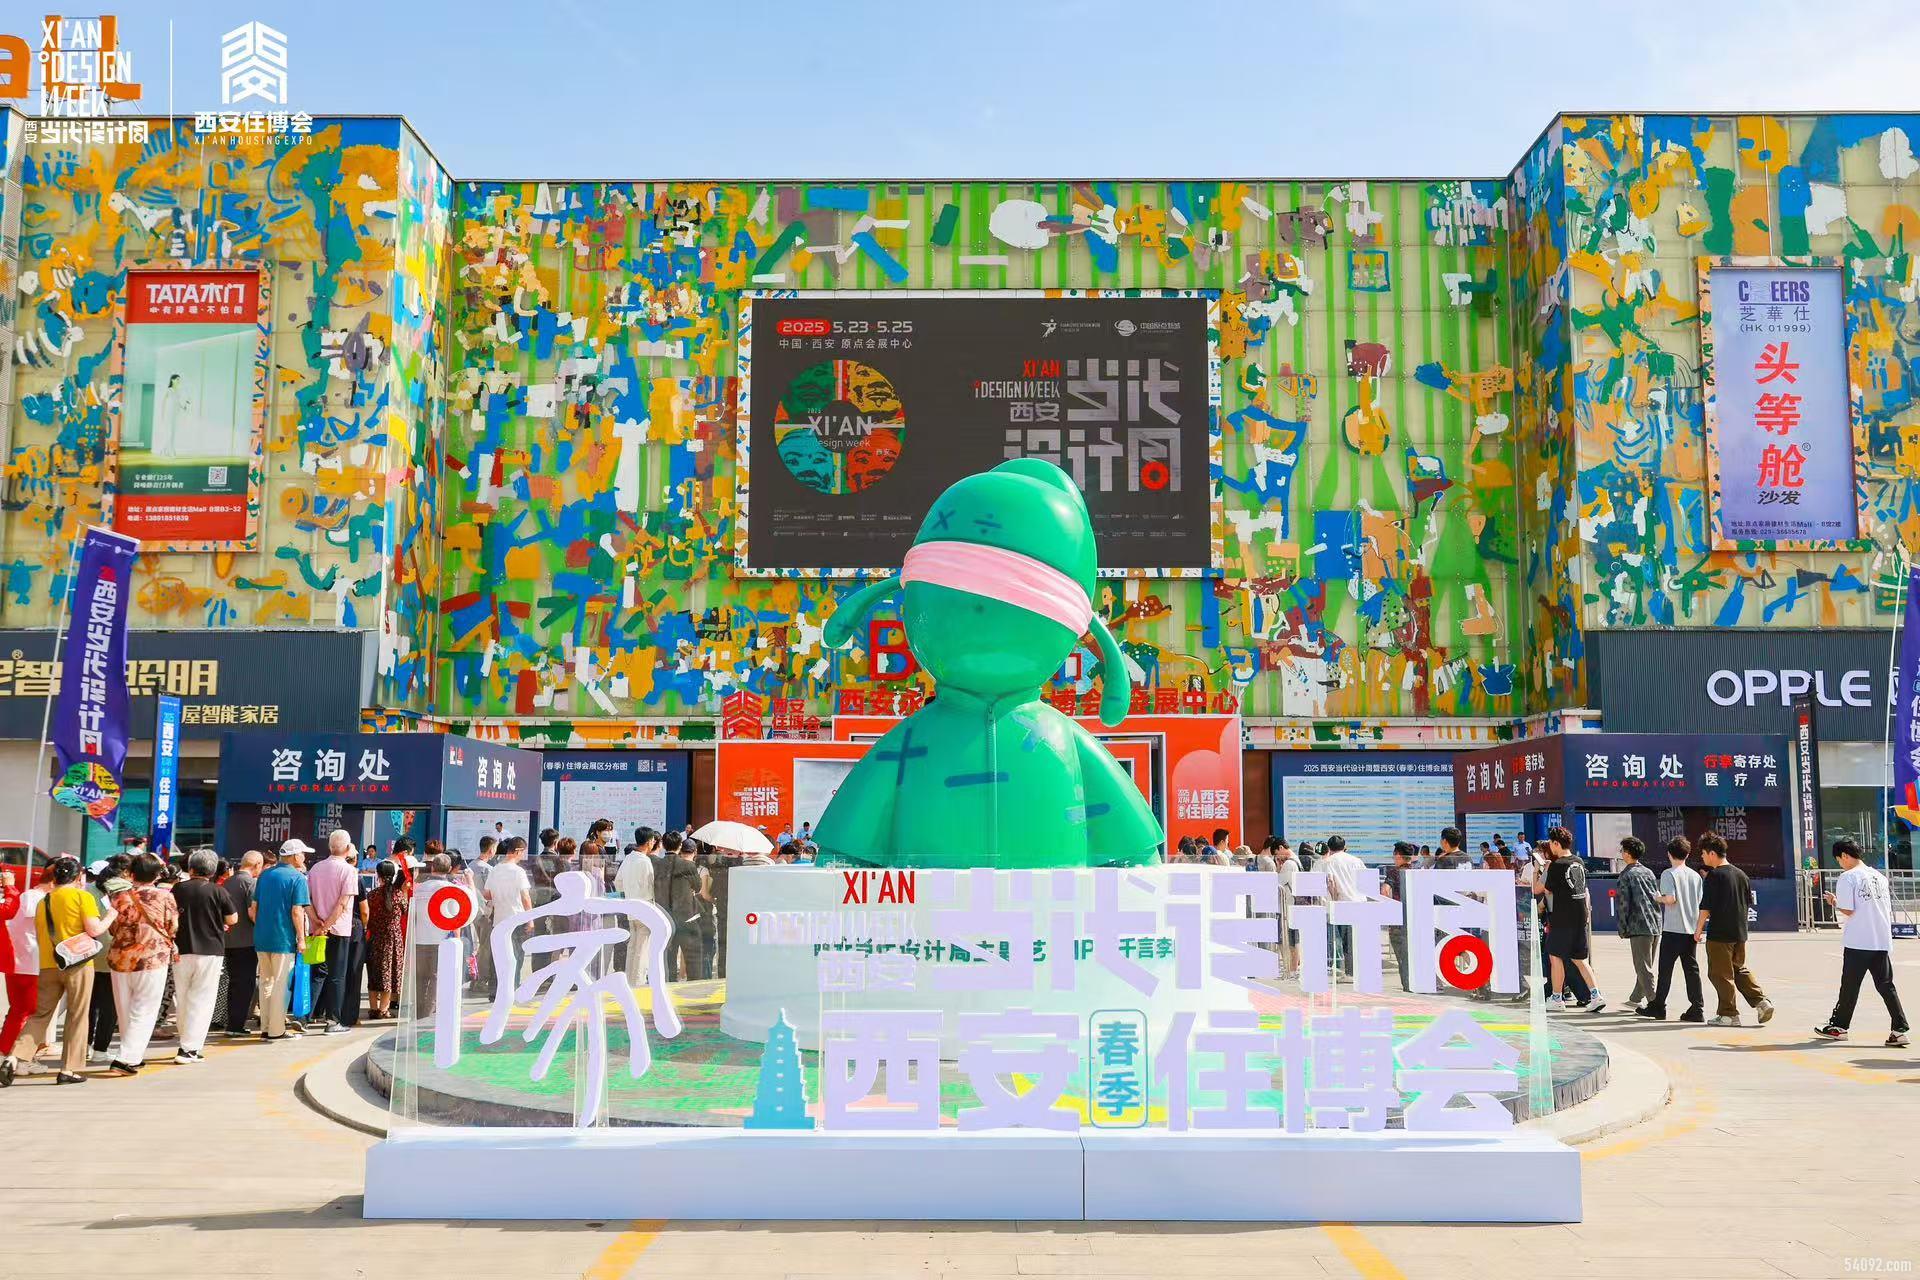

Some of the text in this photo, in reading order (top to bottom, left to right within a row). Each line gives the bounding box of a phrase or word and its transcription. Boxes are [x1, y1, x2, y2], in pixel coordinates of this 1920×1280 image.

[146, 283, 245, 303] TATA木门
[1738, 280, 1811, 302] CEERS
[1740, 306, 1811, 322] 芝華仕
[783, 321, 913, 333] 2025 5.23 5.25
[1740, 324, 1812, 333] (HK 01999)
[779, 339, 913, 349] 中国·西安 原点会展中心
[1023, 360, 1061, 378] XI'AN
[1023, 381, 1061, 399] WEEK
[1067, 358, 1182, 425] 当代
[1010, 401, 1060, 422] 西安
[1754, 341, 1807, 488] 头等舱
[808, 416, 872, 436] XI'AN
[845, 439, 871, 447] week
[1757, 490, 1801, 505] 沙发
[1707, 669, 1872, 707] OPPLE
[181, 705, 279, 724] 屋智能家居
[271, 749, 391, 782] 咨询处
[477, 756, 516, 791] 咨询处
[1303, 764, 1320, 772] 2025
[1585, 754, 1684, 779] 咨询处
[1466, 760, 1505, 793] 咨询处
[1586, 780, 1687, 788] INFORMATION
[1705, 772, 1778, 786] 医疗点
[267, 784, 392, 793] INFORMATION
[1200, 789, 1230, 804] 西安
[1512, 777, 1546, 797] 医疗点
[1187, 803, 1230, 819] 住博会
[842, 870, 915, 904] XI'AN
[931, 867, 1520, 997] 当代设计周
[822, 1008, 1521, 1133] 西安 春季 住博会
